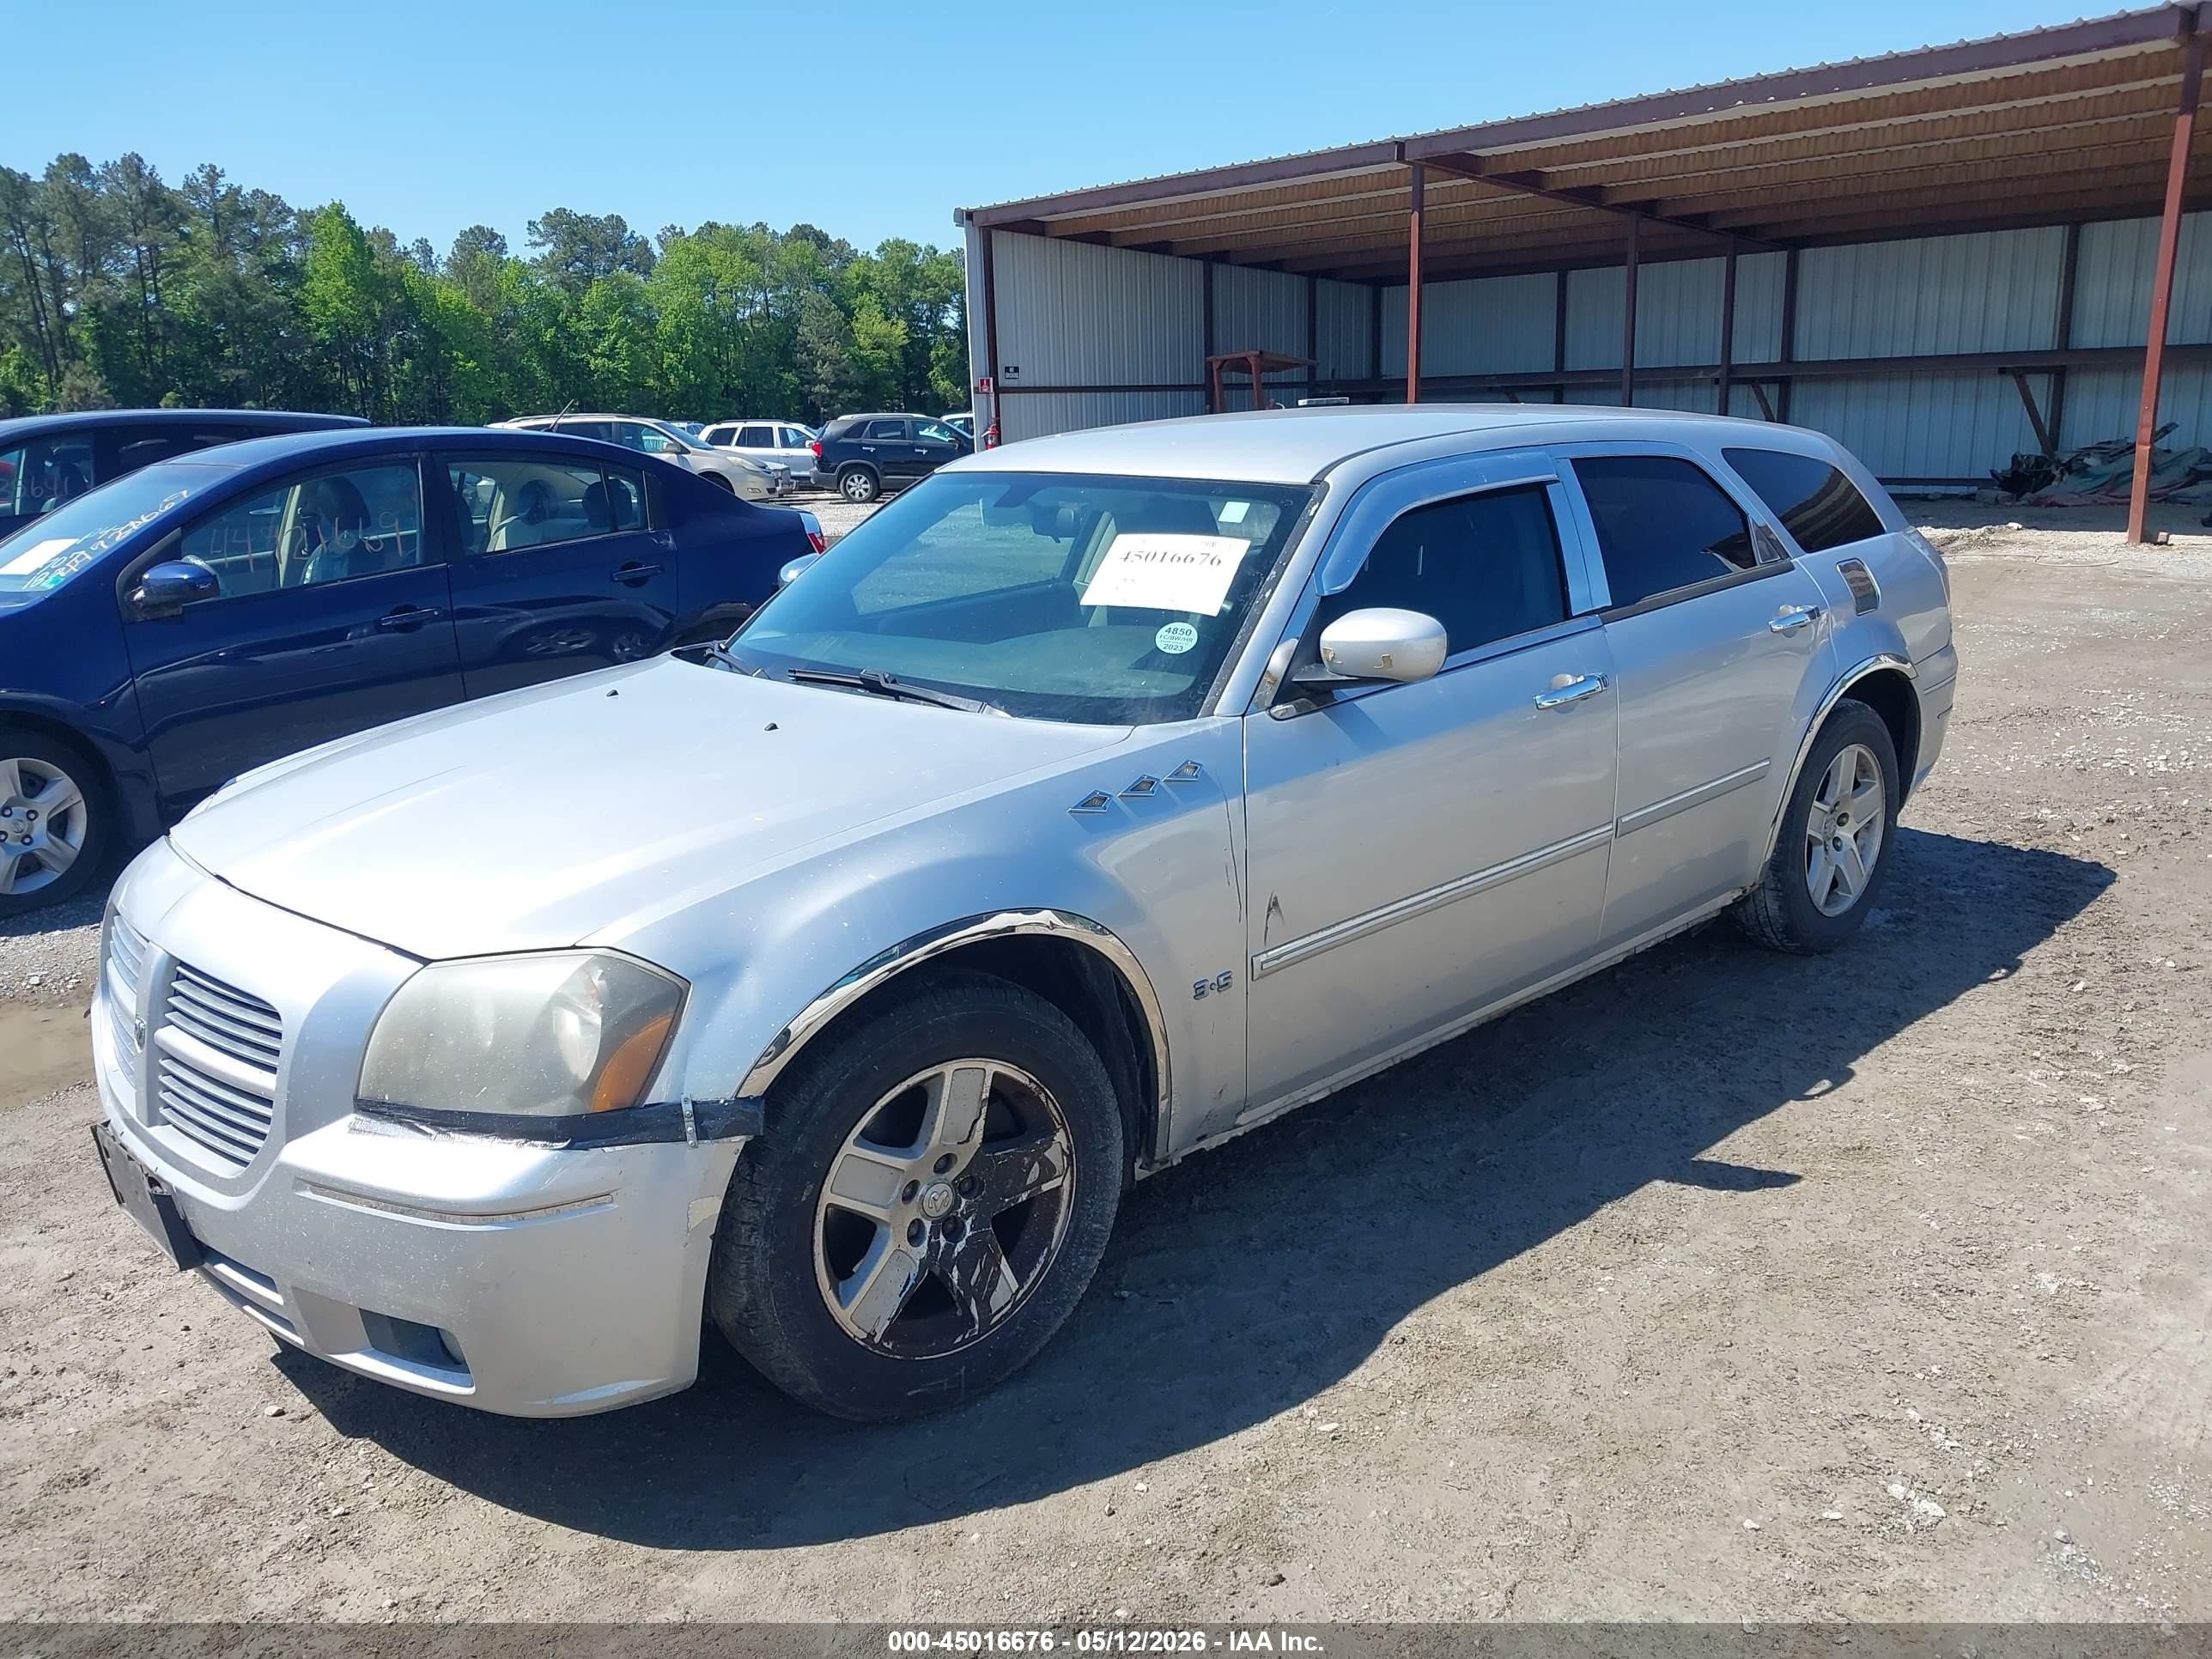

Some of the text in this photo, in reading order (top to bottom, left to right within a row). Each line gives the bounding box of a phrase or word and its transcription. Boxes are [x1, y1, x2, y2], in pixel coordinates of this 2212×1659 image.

[1119, 550, 1222, 568] 45016676
[1164, 627, 1193, 637] 4850
[1163, 643, 1184, 653] 2023
